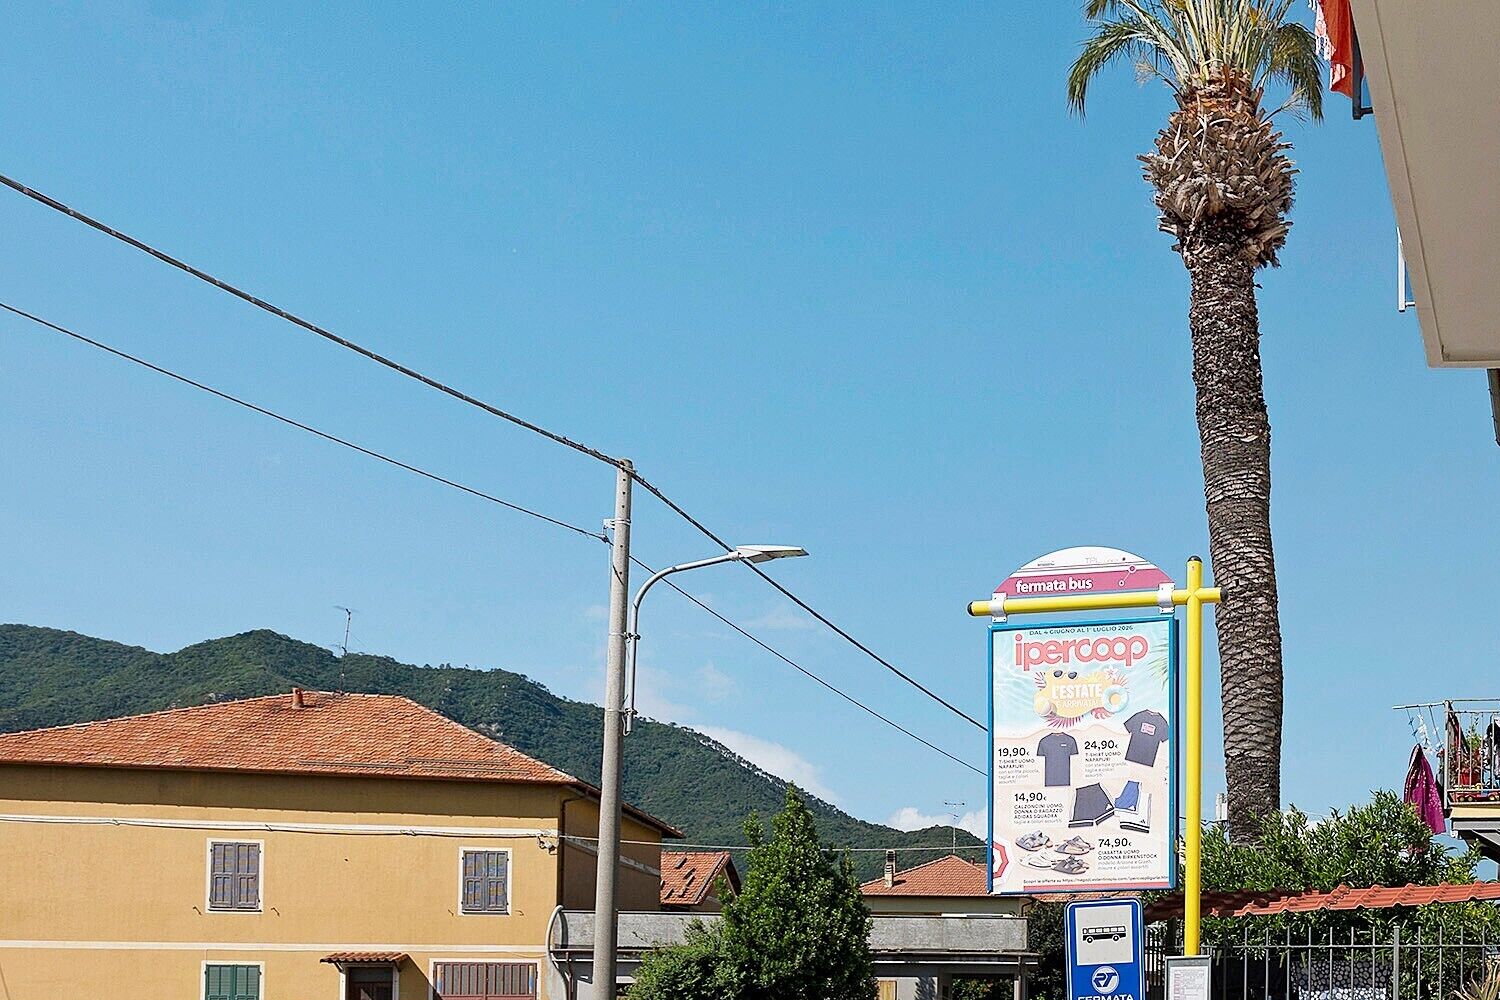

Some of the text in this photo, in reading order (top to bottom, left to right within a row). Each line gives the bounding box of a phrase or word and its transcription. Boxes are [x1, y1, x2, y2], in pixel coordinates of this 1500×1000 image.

[1016, 576, 1092, 593] fermata bus
[1015, 634, 1148, 671] ipercoop
[1051, 684, 1103, 699] L'ESTATE
[1084, 740, 1118, 751] 24,90€
[998, 748, 1030, 758] 19,90€
[1014, 792, 1047, 803] 14,90€
[1098, 838, 1132, 848] 74,90€
